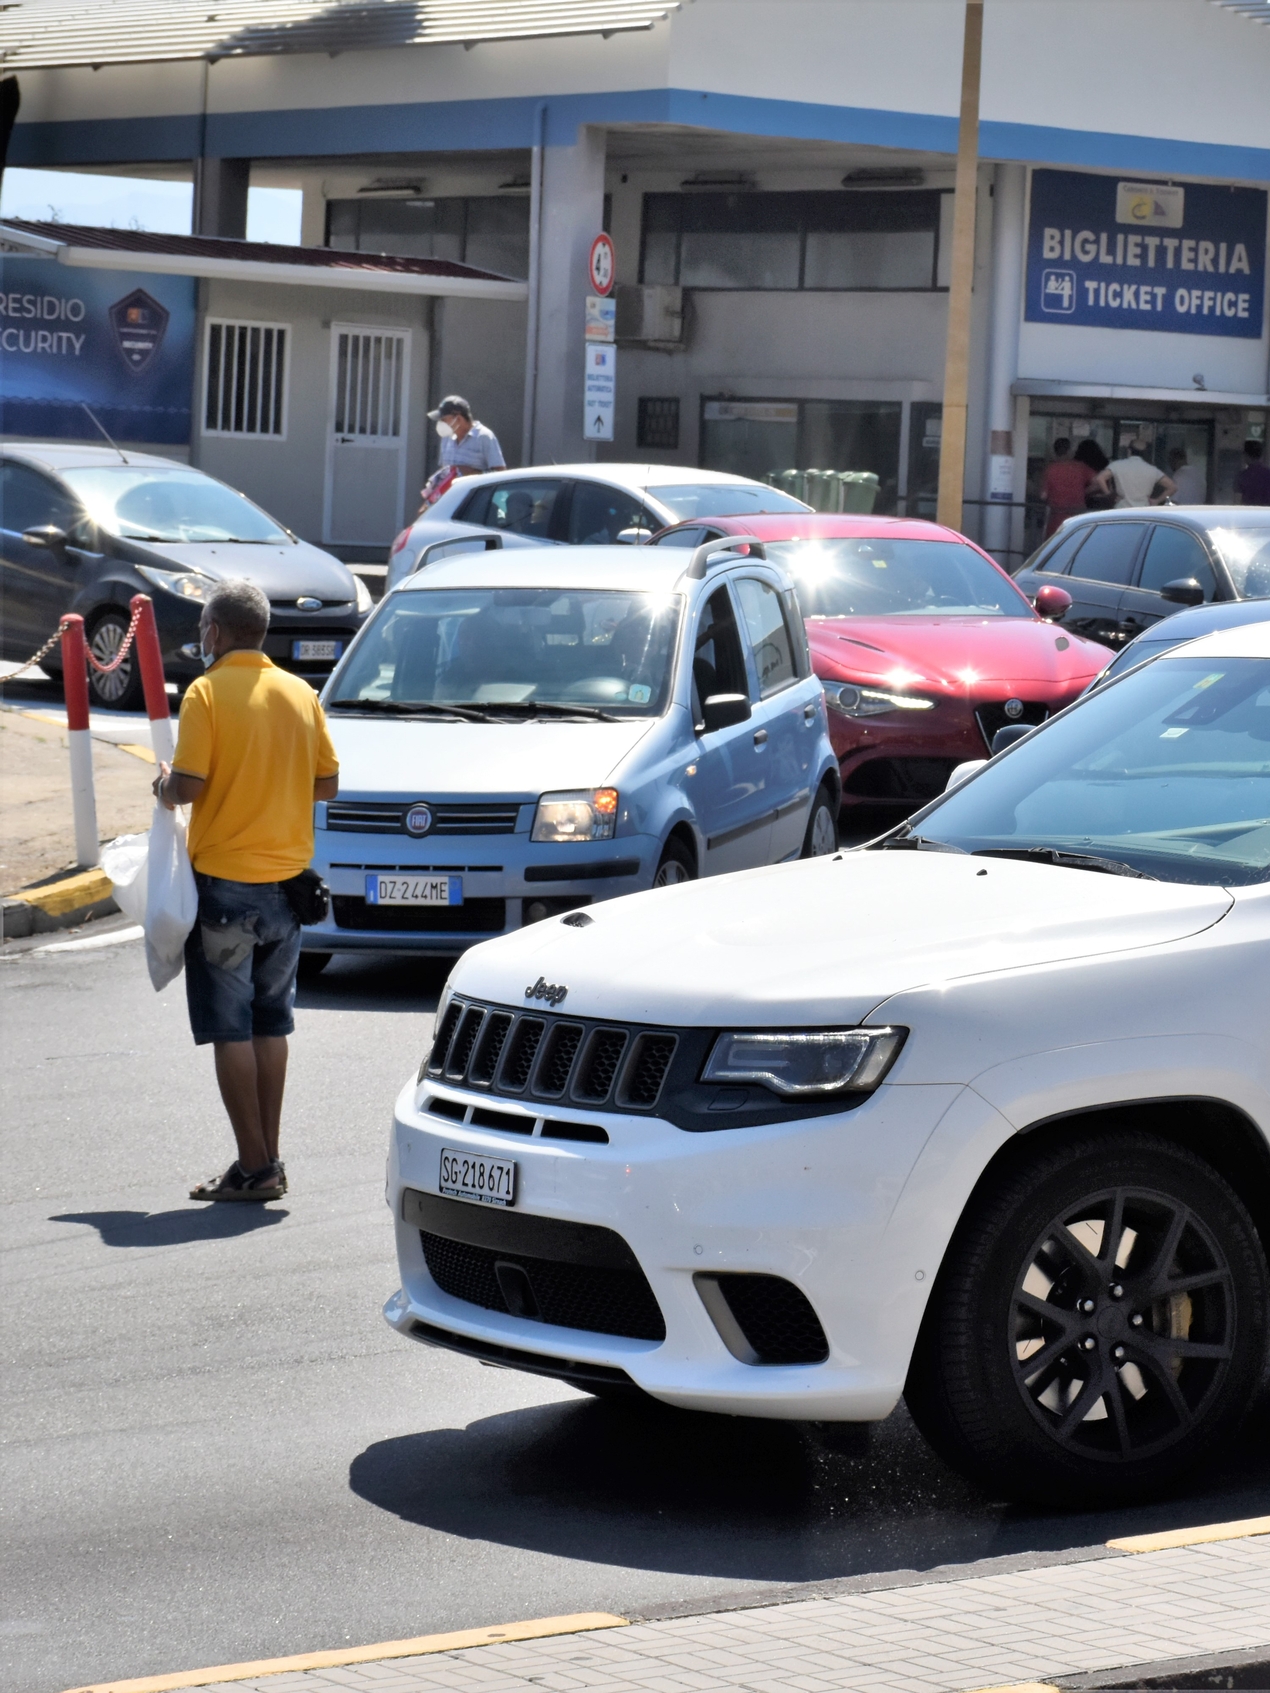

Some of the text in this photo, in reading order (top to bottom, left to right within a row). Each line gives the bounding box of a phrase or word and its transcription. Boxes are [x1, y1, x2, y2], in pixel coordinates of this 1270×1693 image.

[1042, 227, 1251, 275] BIGLIETTERIA
[1084, 281, 1250, 318] TICKET OFFICE
[411, 815, 427, 827] FIAT
[525, 976, 568, 1008] Jeep
